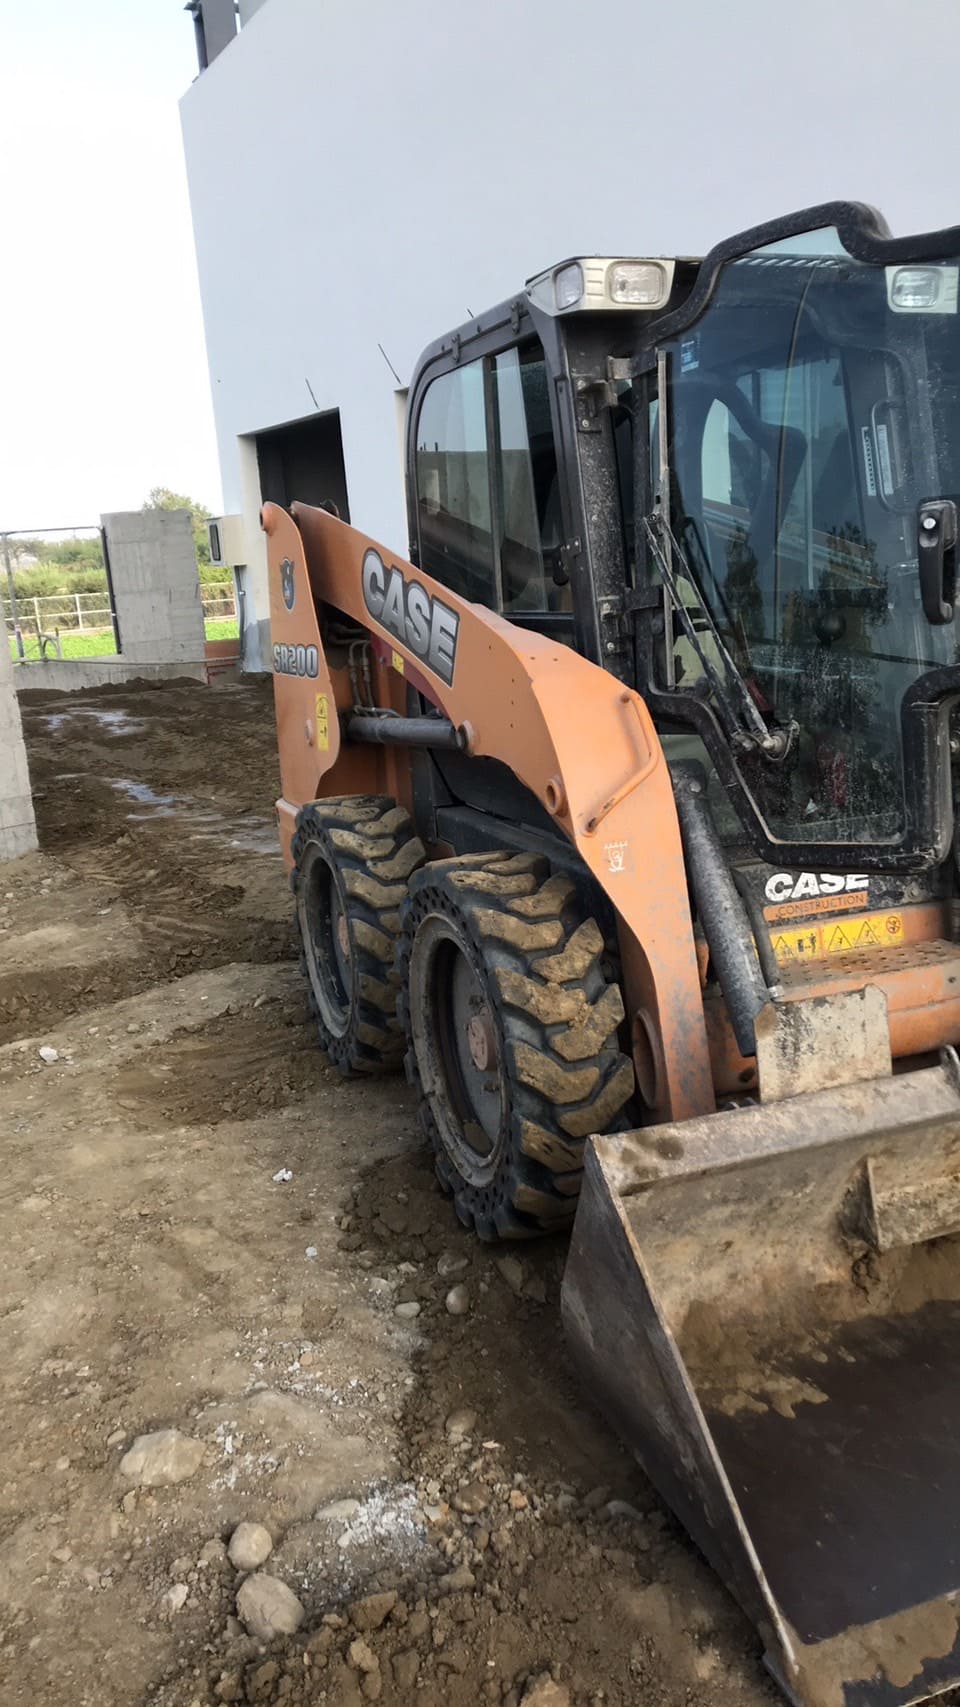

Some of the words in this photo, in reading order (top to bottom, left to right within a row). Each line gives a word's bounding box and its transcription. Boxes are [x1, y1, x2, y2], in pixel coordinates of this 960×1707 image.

[362, 548, 459, 688] CASE
[273, 643, 318, 678] SR200
[777, 894, 864, 918] CONSTRUCTION
